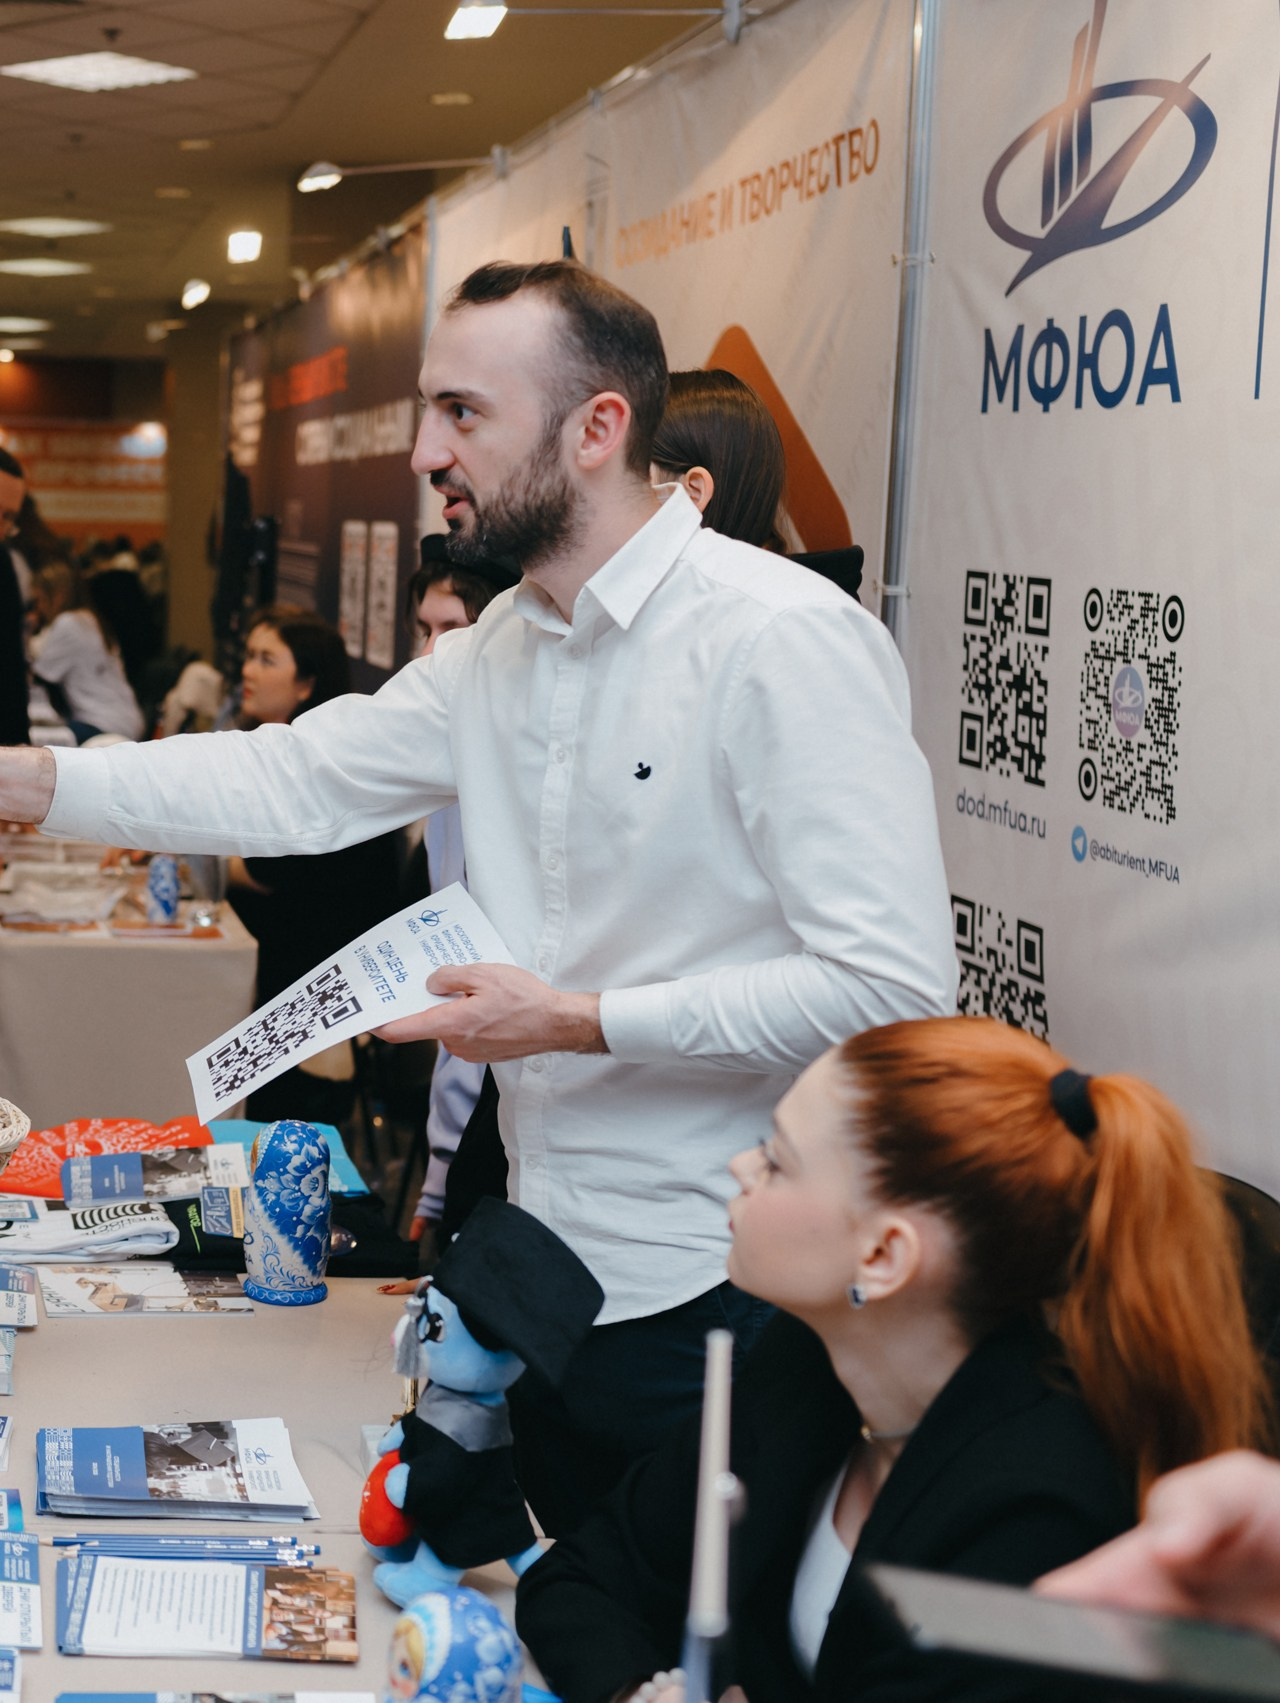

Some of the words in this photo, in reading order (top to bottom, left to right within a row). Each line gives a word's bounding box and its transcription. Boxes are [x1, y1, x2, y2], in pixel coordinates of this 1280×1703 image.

[718, 183, 735, 234] И
[738, 118, 881, 226] ТВОРЧЕСТВО
[980, 303, 1182, 414] МФЮА
[956, 787, 1047, 840] dod.mfua.ru
[1089, 838, 1181, 885] @abiturient_MFUA
[405, 916, 422, 935] МФЮА
[453, 923, 483, 963] МОСКОВСКИЙ
[376, 940, 398, 961] ОДИН
[383, 956, 409, 983] ДЕНЬ
[356, 948, 397, 1004] УНИВЕРСИТЕТЕ
